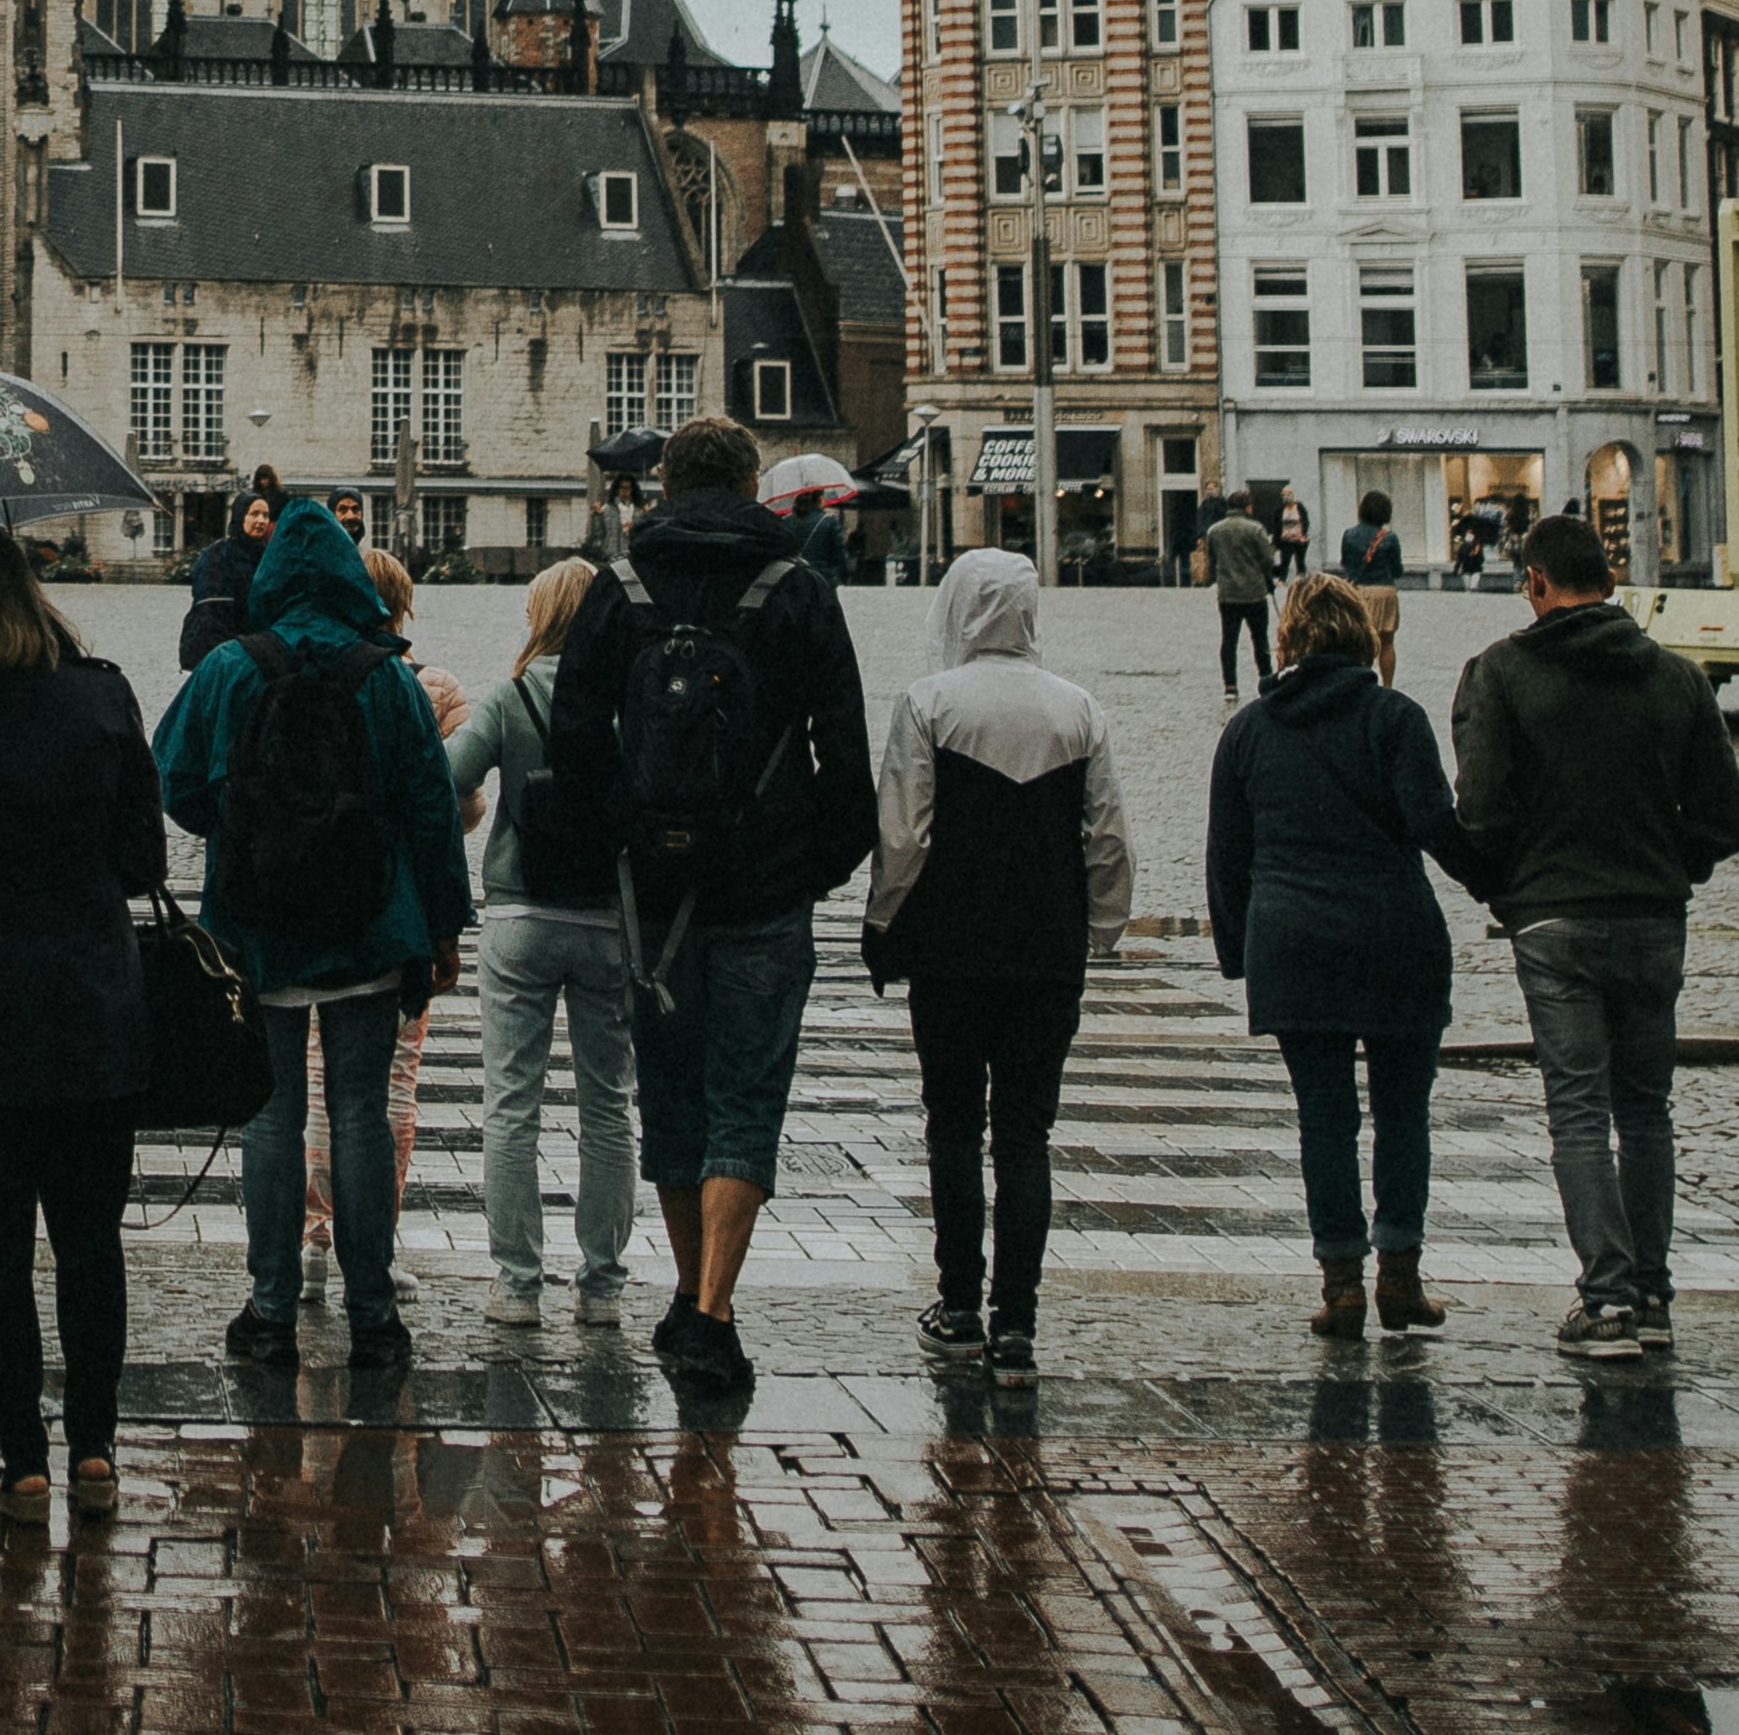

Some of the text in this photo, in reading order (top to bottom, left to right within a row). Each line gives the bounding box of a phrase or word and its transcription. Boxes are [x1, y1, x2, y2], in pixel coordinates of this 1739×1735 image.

[1396, 428, 1479, 444] SWAROVSKI
[972, 467, 1037, 482] & MORE
